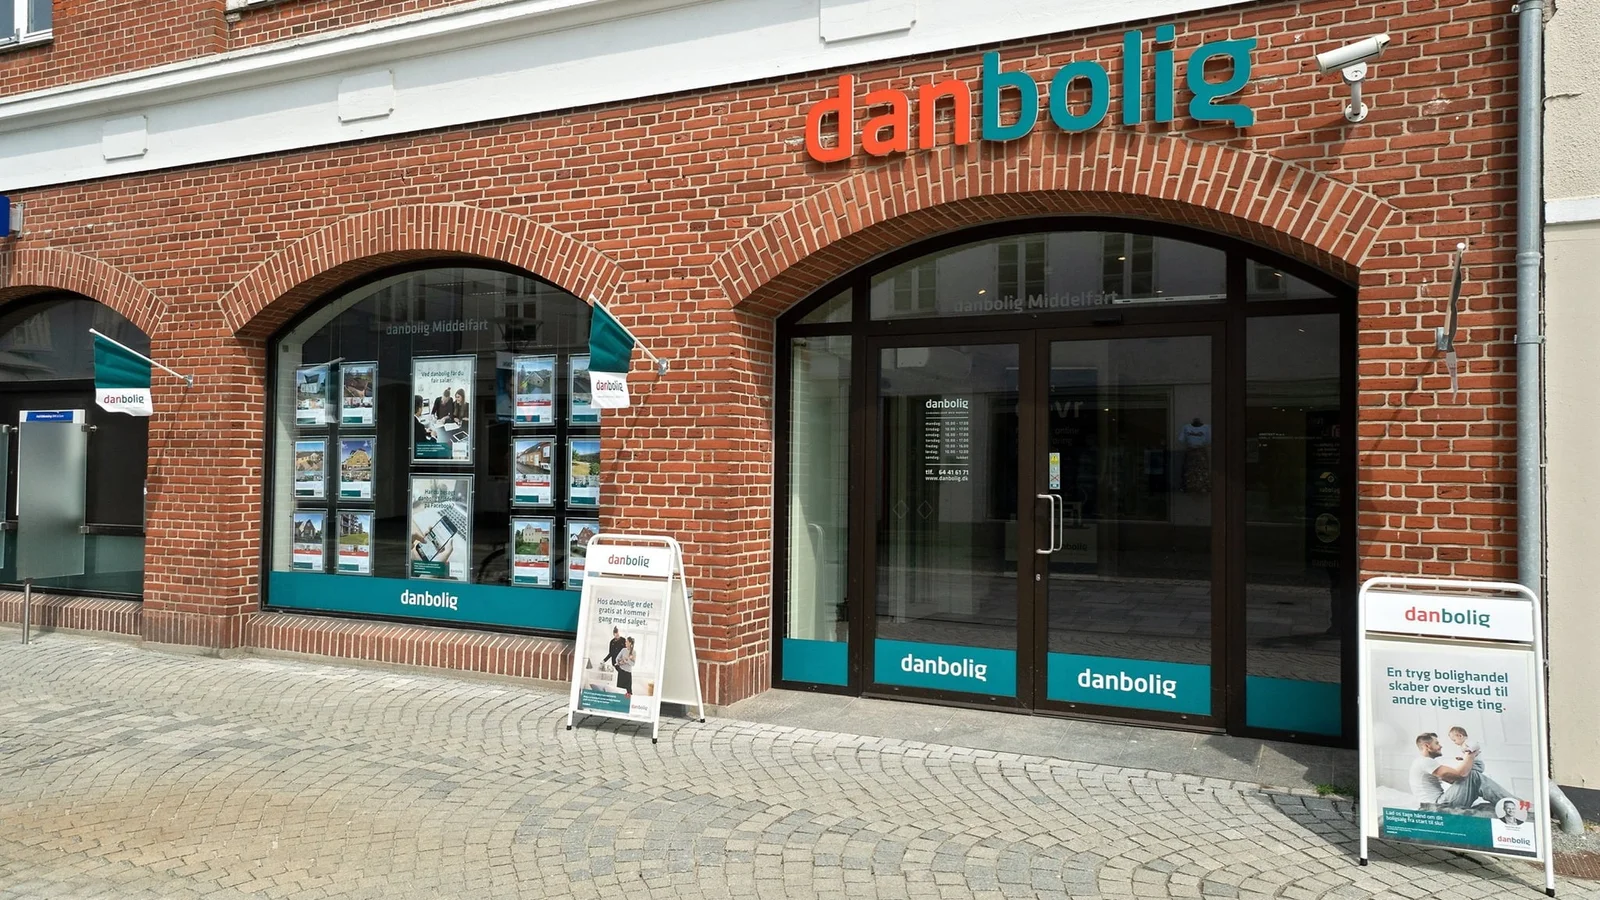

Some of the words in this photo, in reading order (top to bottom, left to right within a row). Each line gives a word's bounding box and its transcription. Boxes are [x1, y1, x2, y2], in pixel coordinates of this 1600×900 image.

[805, 24, 1256, 163] danbolig
[954, 296, 1024, 313] danbolig
[1028, 290, 1118, 308] Middelfart
[386, 322, 430, 336] danbolig
[432, 319, 488, 333] Middelfart
[596, 380, 623, 392] danbolig
[104, 394, 144, 404] danbolig
[926, 399, 968, 409] danbolig
[608, 554, 650, 568] danbolig
[401, 589, 458, 611] danbolig
[609, 599, 635, 608] danbolig
[643, 601, 653, 609] det
[624, 608, 646, 616] komme
[1405, 606, 1490, 628] danbolig
[599, 616, 612, 624] gang
[628, 618, 648, 626] salget.
[901, 654, 988, 682] danbolig
[1387, 667, 1402, 677] En
[1405, 669, 1431, 681] tryg
[1434, 669, 1508, 683] bolighandel
[1077, 668, 1177, 699] danbolig
[1389, 681, 1429, 692] skaber
[1433, 684, 1491, 696] overskud
[1495, 686, 1508, 697] til
[1392, 695, 1427, 705] andre
[1430, 696, 1473, 711] vigtige
[1477, 699, 1506, 713] ting.
[1498, 836, 1530, 846] danbolig
